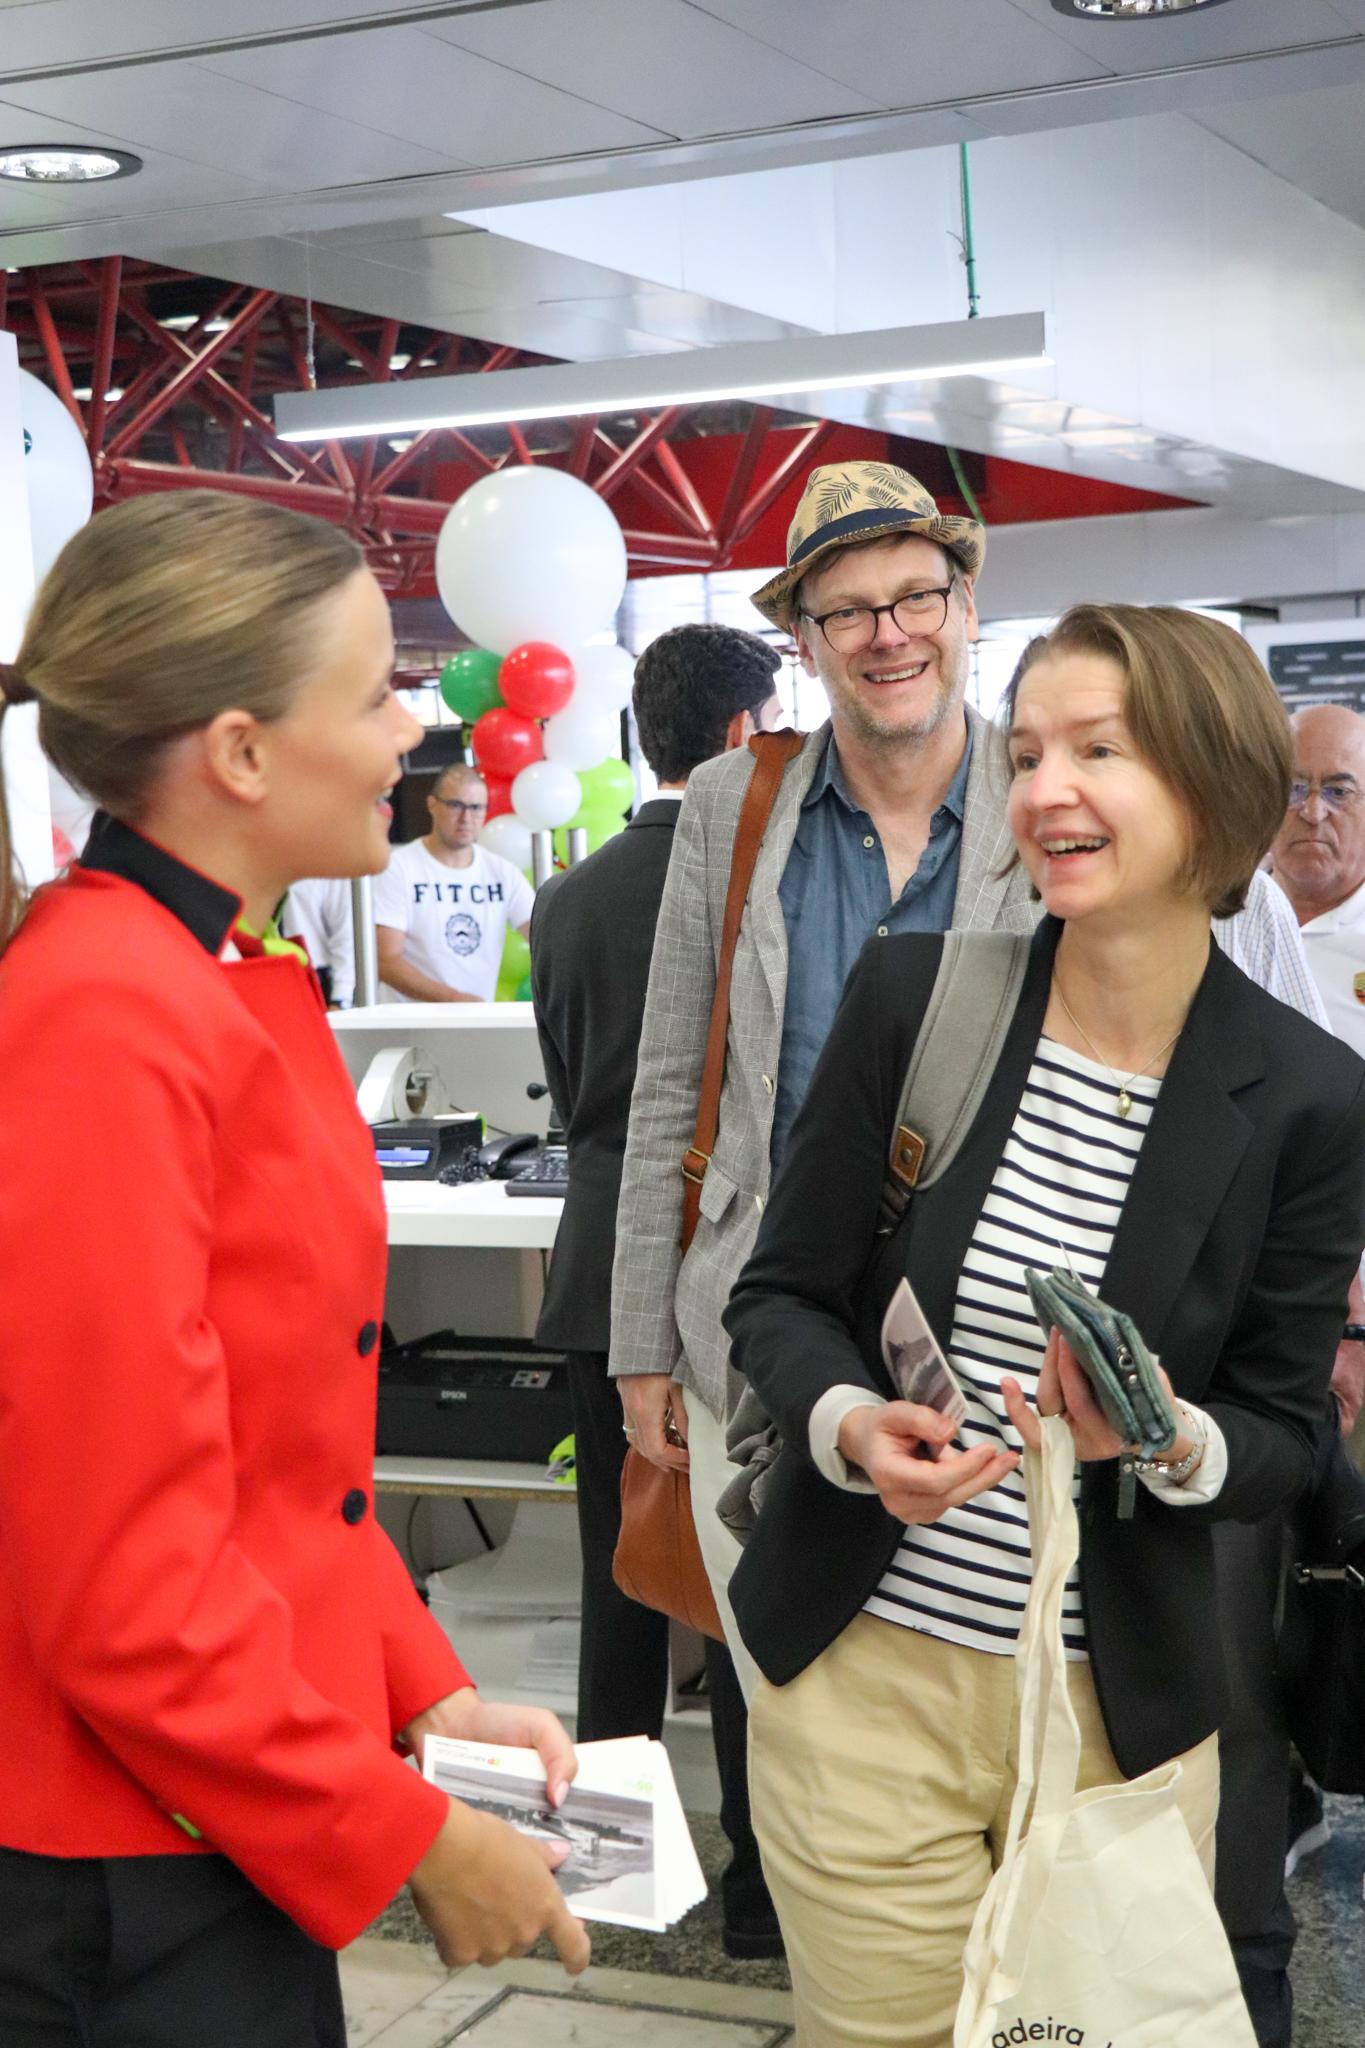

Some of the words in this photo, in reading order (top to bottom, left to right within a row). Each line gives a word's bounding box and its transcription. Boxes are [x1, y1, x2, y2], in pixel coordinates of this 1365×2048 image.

[413, 883, 504, 904] FITCH
[441, 1390, 468, 1400] EPSON
[991, 2016, 1085, 2048] adeira
